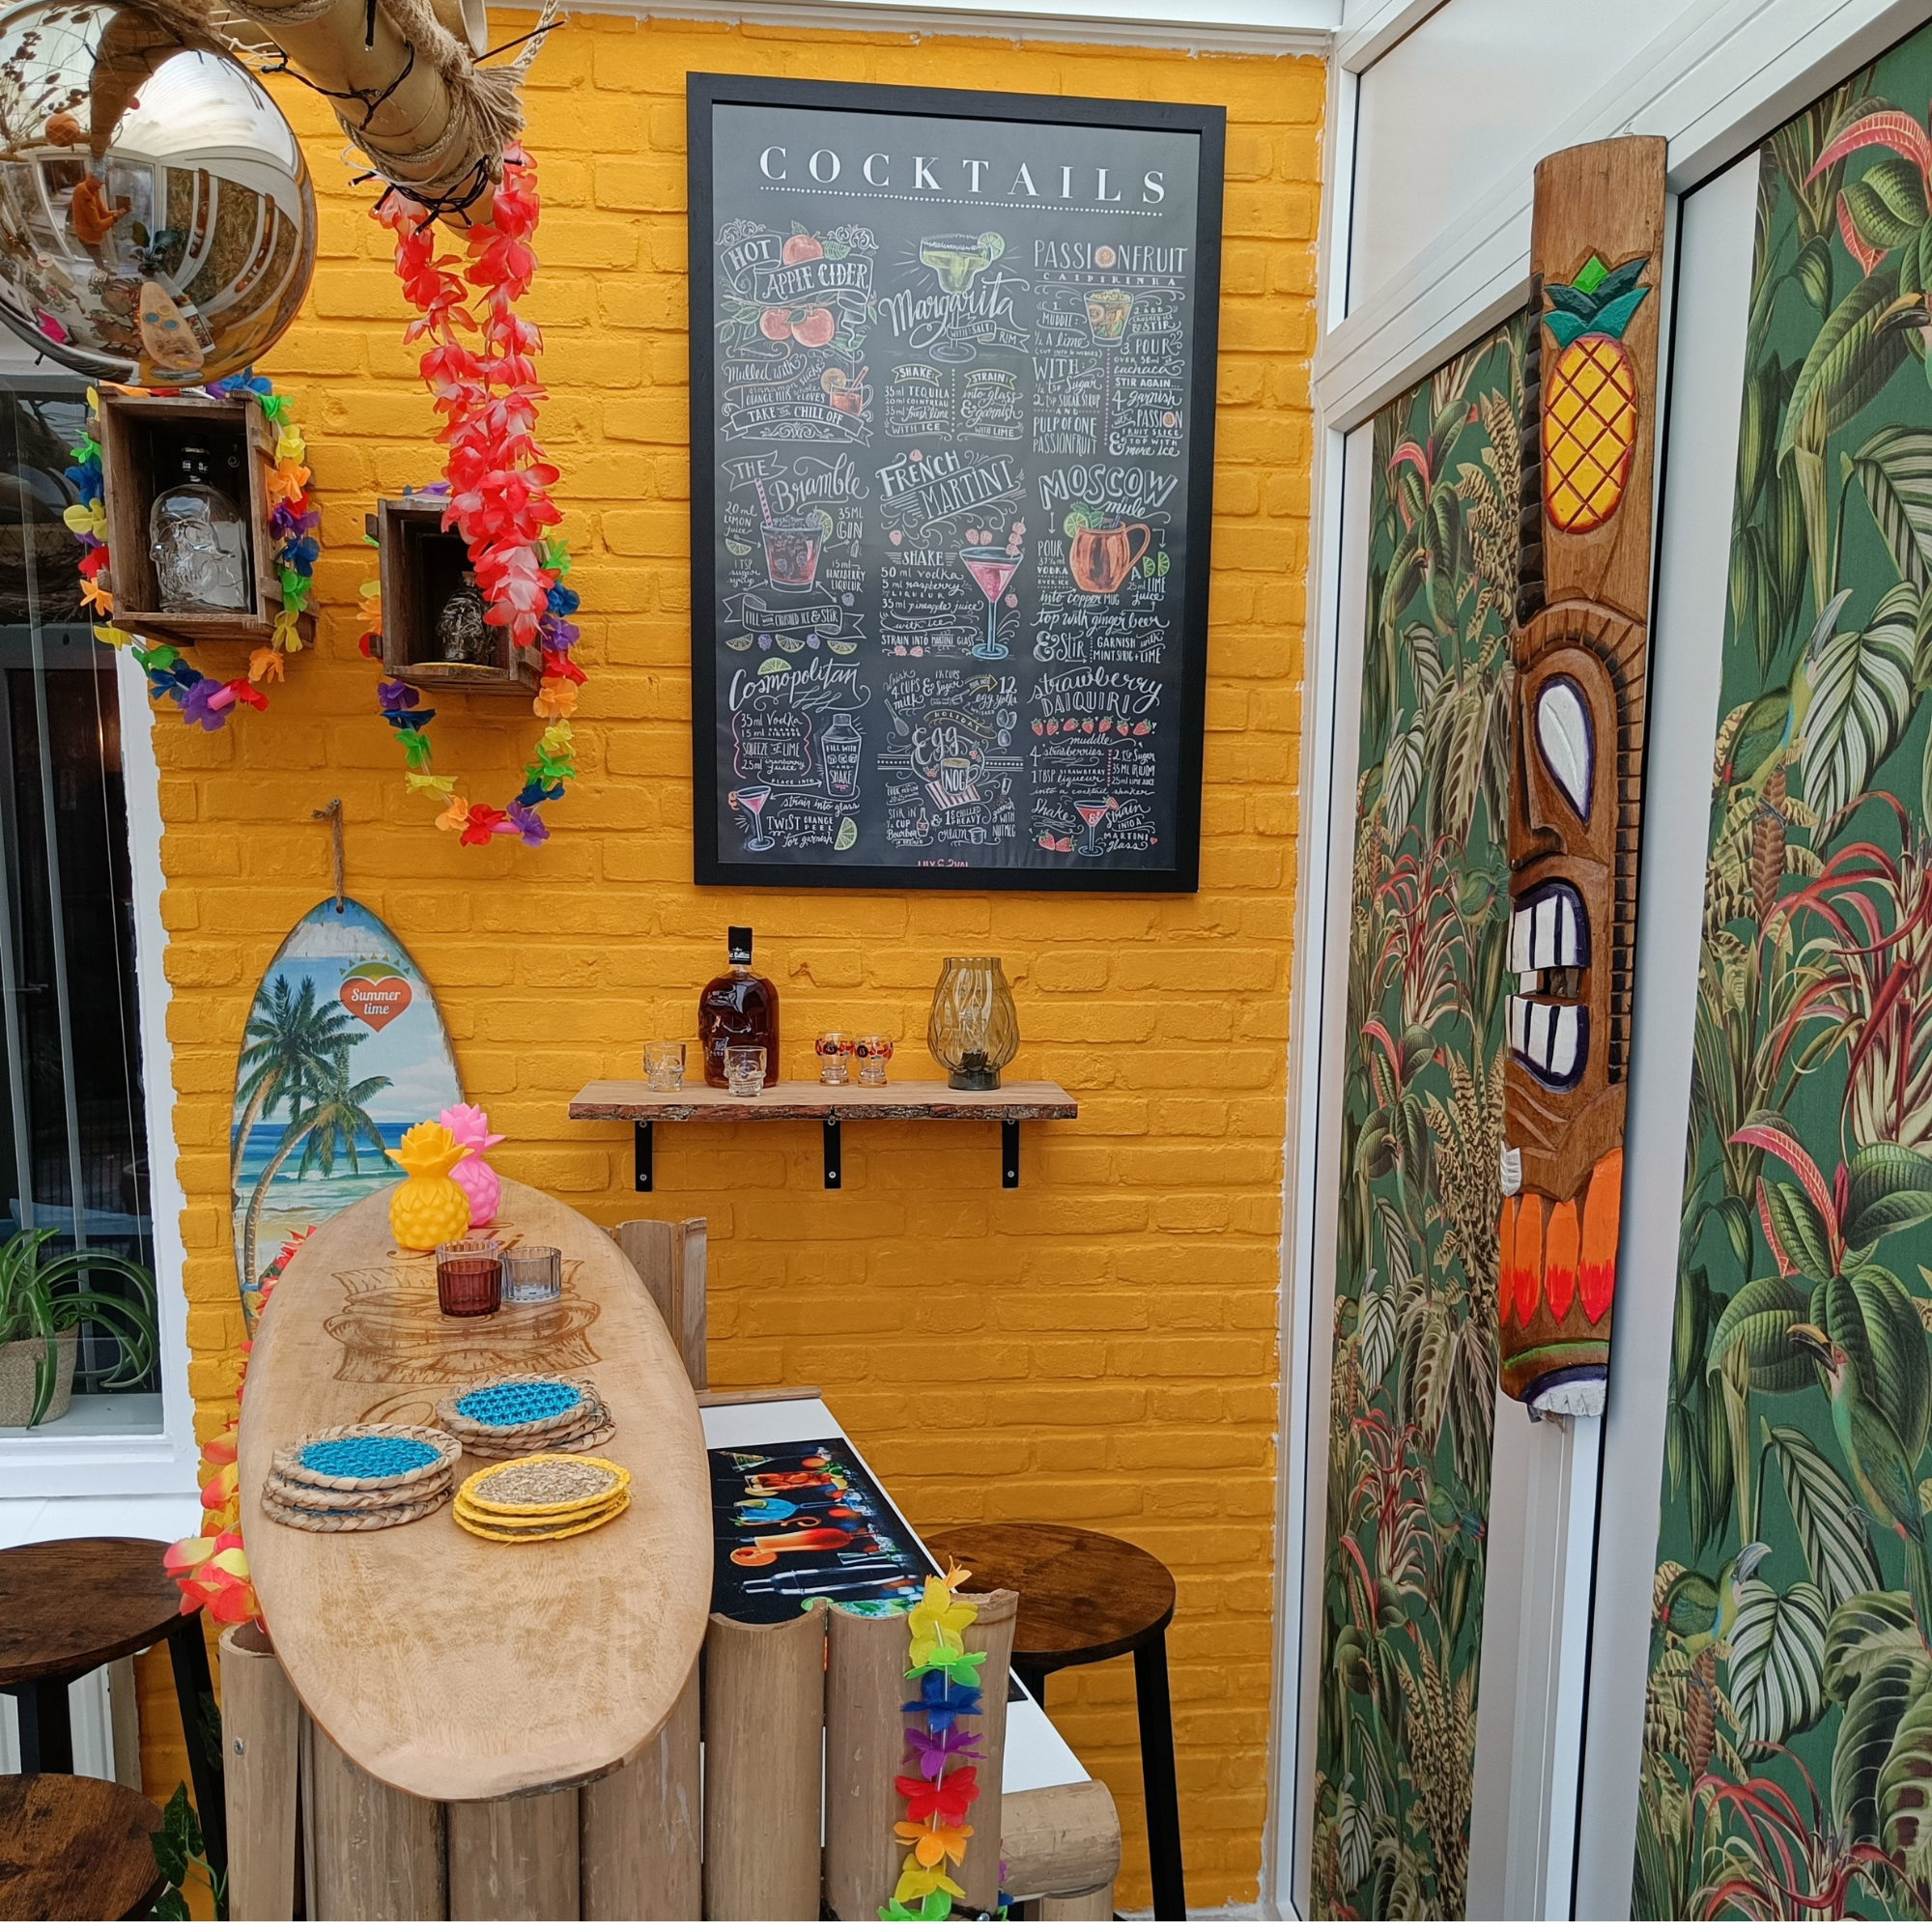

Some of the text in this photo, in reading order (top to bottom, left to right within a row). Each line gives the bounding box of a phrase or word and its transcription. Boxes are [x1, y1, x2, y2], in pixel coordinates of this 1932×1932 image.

[758, 145, 1166, 205] COCKTAILS
[728, 240, 772, 270] HOT
[1035, 240, 1188, 272] PASSIONFRUIT
[762, 264, 868, 300] APPLE CIDER
[1043, 272, 1176, 286] CAIPIRINHA
[878, 273, 1027, 348] Margarita
[972, 324, 989, 334] SALT
[1143, 321, 1176, 330] STIR
[999, 330, 1017, 345] RIM
[1046, 331, 1090, 348] A lime
[1136, 339, 1179, 355] POUR
[724, 354, 801, 383] Mulled with
[1116, 378, 1136, 386] STIR
[909, 386, 950, 399] TEQUILA
[962, 386, 1023, 408] into glass
[1034, 394, 1080, 407] 2 SUGAR
[1127, 390, 1181, 408] garnish
[747, 406, 843, 425] TAKE CHILL OFF
[928, 410, 949, 420] lime
[961, 400, 1023, 428] & garnish
[1137, 411, 1182, 429] PASSION
[892, 424, 917, 434] WITH
[993, 427, 1013, 437] LIME
[1034, 417, 1097, 438] PULP OF ONE
[1033, 434, 1097, 456] PASSIONFRUIT
[1109, 432, 1126, 455] &
[1125, 446, 1155, 456] more
[733, 460, 769, 479] THE
[875, 449, 960, 497] FRENCH
[769, 453, 869, 514] Bramble
[919, 461, 1013, 519] MARTINI
[1038, 464, 1179, 510] MOSCOW
[1092, 497, 1154, 519] mule
[724, 515, 752, 526] LEMON
[837, 522, 863, 539] GIN
[1037, 540, 1064, 556] POUR
[739, 559, 753, 570] TSP
[902, 551, 944, 566] SHAKE
[826, 569, 866, 582] BLACKBERRY
[918, 568, 964, 580] vodka
[832, 580, 863, 592] LIQUEUR
[882, 580, 964, 596] 5 raspberry
[1148, 578, 1166, 593] LIME
[1039, 590, 1120, 607] into copper MUG
[1132, 593, 1164, 606] juice
[908, 601, 983, 613] pineapple juice
[746, 611, 820, 626] FILL CRUSHED ICE &
[1030, 608, 1170, 637] top with ginger beer
[881, 635, 909, 645] STRAIN
[912, 635, 928, 645] INTO
[957, 636, 975, 646] GLASS
[1034, 631, 1059, 662] &
[1097, 638, 1136, 648] GARNISH
[1094, 649, 1160, 664] MINT SPRIG LIME
[945, 669, 960, 679] CUPS
[728, 657, 861, 711] Cosmopolitan
[892, 678, 920, 699] 4 CUPS
[923, 678, 935, 696] &
[1000, 676, 1017, 694] 12
[1027, 667, 1162, 714] strawberry
[894, 694, 924, 710] milk
[972, 694, 994, 710] egg
[1041, 692, 1130, 721] DAIQUIRI
[935, 711, 980, 732] HOLIDAY
[783, 743, 800, 757] LIME
[912, 724, 959, 765] Egg
[1030, 746, 1041, 767] 4
[1113, 751, 1121, 759] 2
[830, 770, 852, 783] SHAKE
[1032, 770, 1055, 783] 1 TBSP
[1132, 765, 1155, 777] RUM
[944, 769, 965, 792] NOG
[781, 796, 860, 817] strain into glass
[1032, 798, 1076, 821] Shake
[767, 814, 801, 830] TWIST
[931, 806, 980, 827] & CHILLED
[956, 814, 980, 824] HEAVY
[1000, 812, 1014, 823] WITH
[992, 824, 1015, 837] NUTMEG
[1119, 821, 1136, 830] INTO
[800, 834, 834, 848] garnish
[938, 829, 970, 841] cream
[1106, 838, 1149, 852] glass
[352, 988, 401, 1001] Summer
[364, 1003, 389, 1014] time
